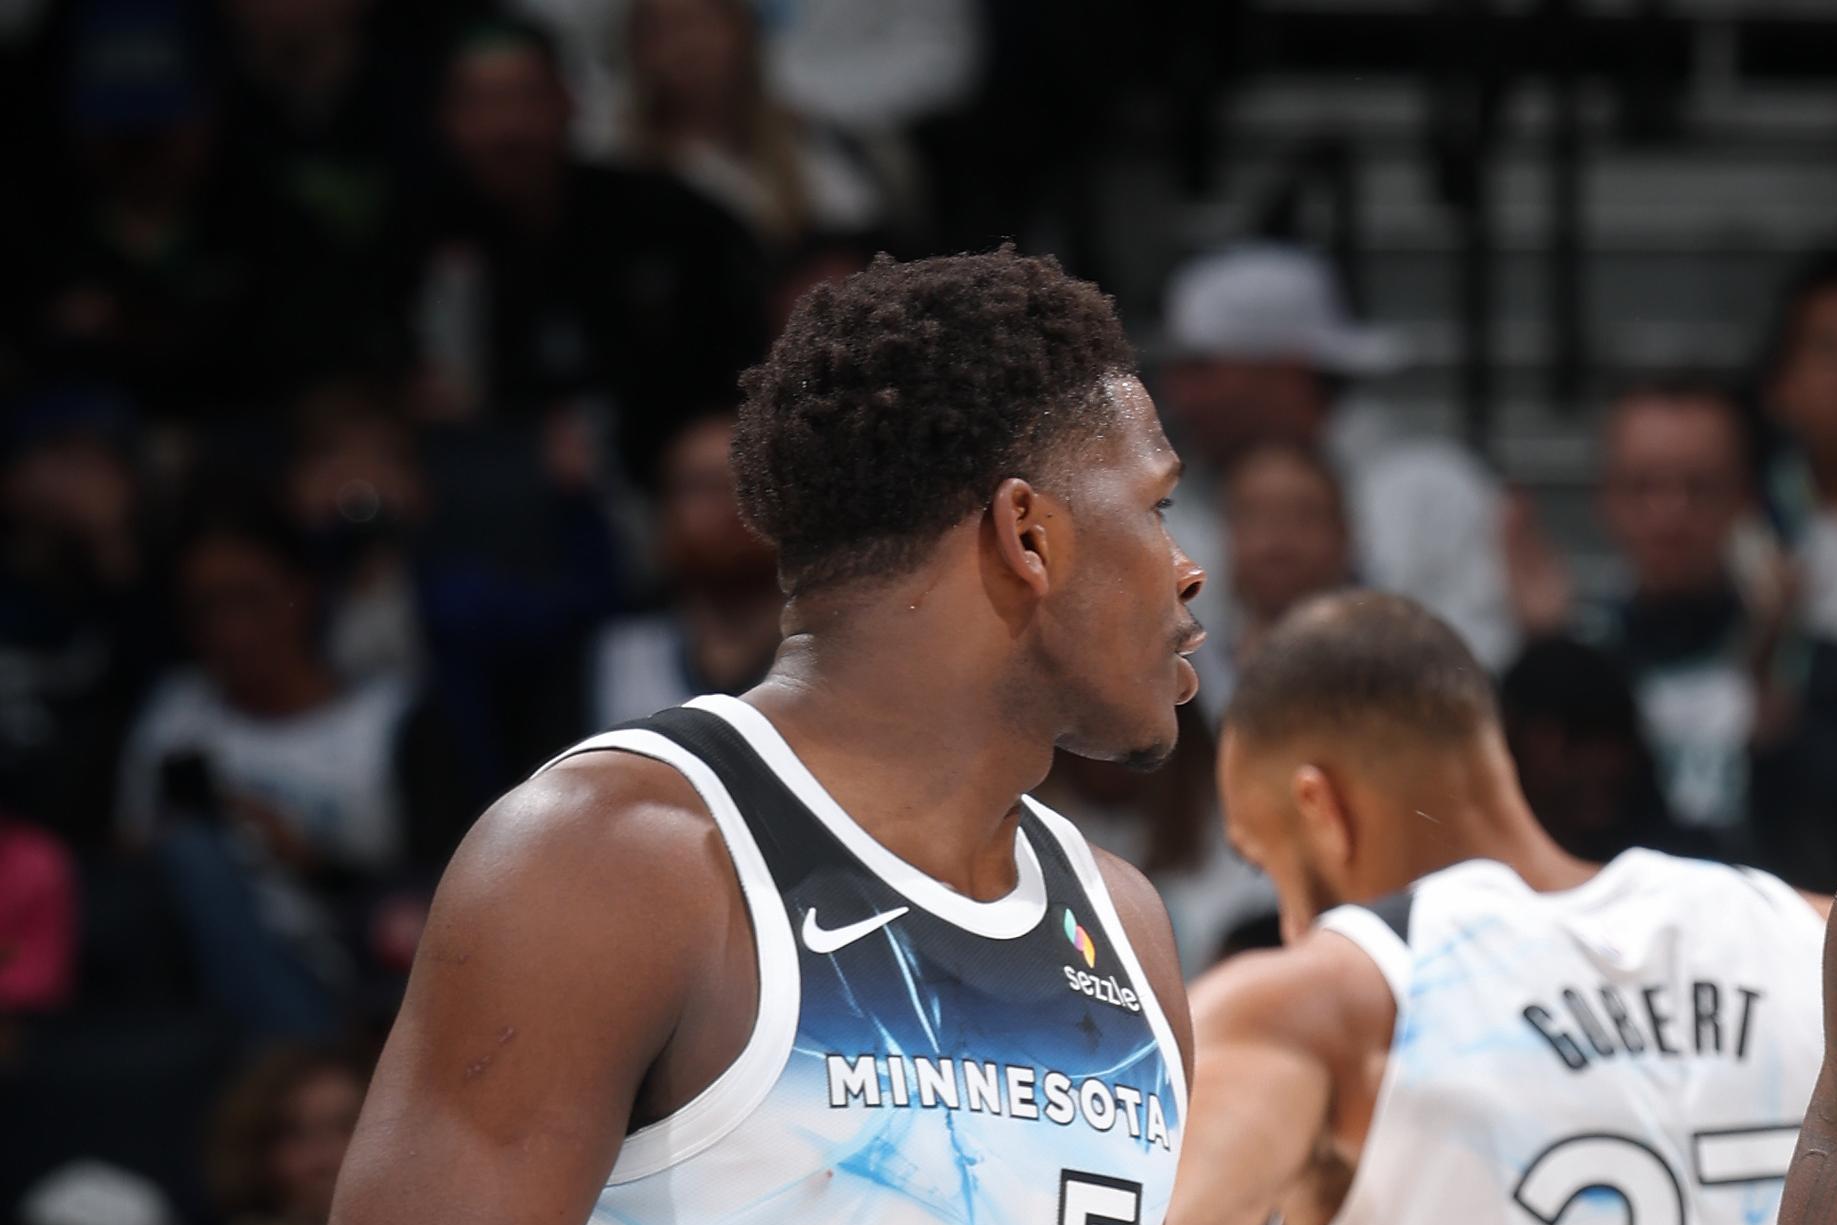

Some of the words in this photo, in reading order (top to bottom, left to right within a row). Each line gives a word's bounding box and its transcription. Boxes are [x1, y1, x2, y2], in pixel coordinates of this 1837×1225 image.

[1063, 964, 1141, 1013] sezzle
[1521, 980, 1764, 1072] GOBERT
[826, 1053, 1171, 1151] MINNESOTA
